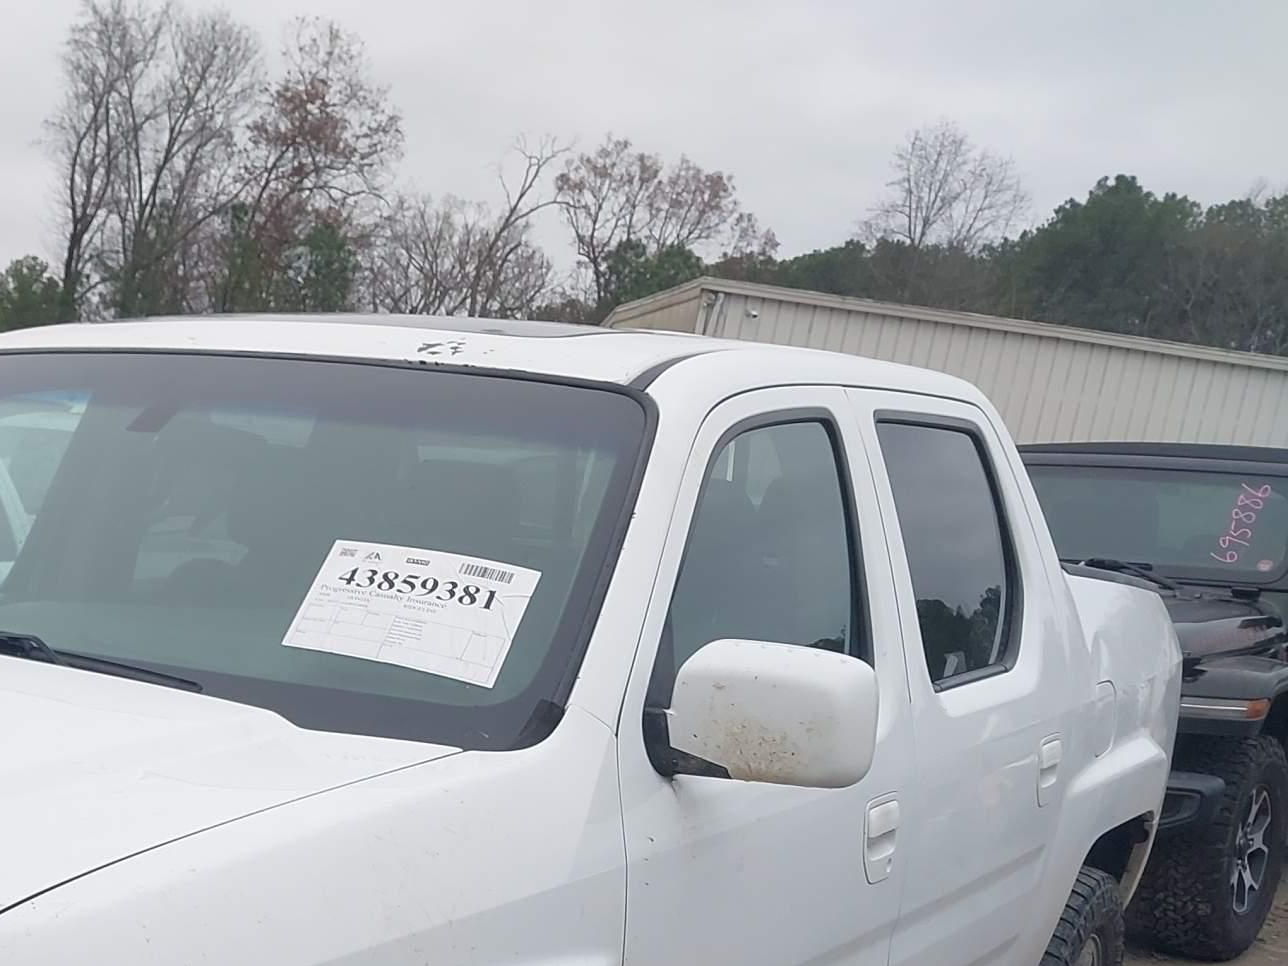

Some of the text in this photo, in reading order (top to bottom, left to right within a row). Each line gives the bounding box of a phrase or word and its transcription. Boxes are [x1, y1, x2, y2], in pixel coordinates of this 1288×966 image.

[1210, 483, 1271, 563] 695886
[338, 567, 497, 611] 43859381
[405, 596, 448, 609] Insurance
